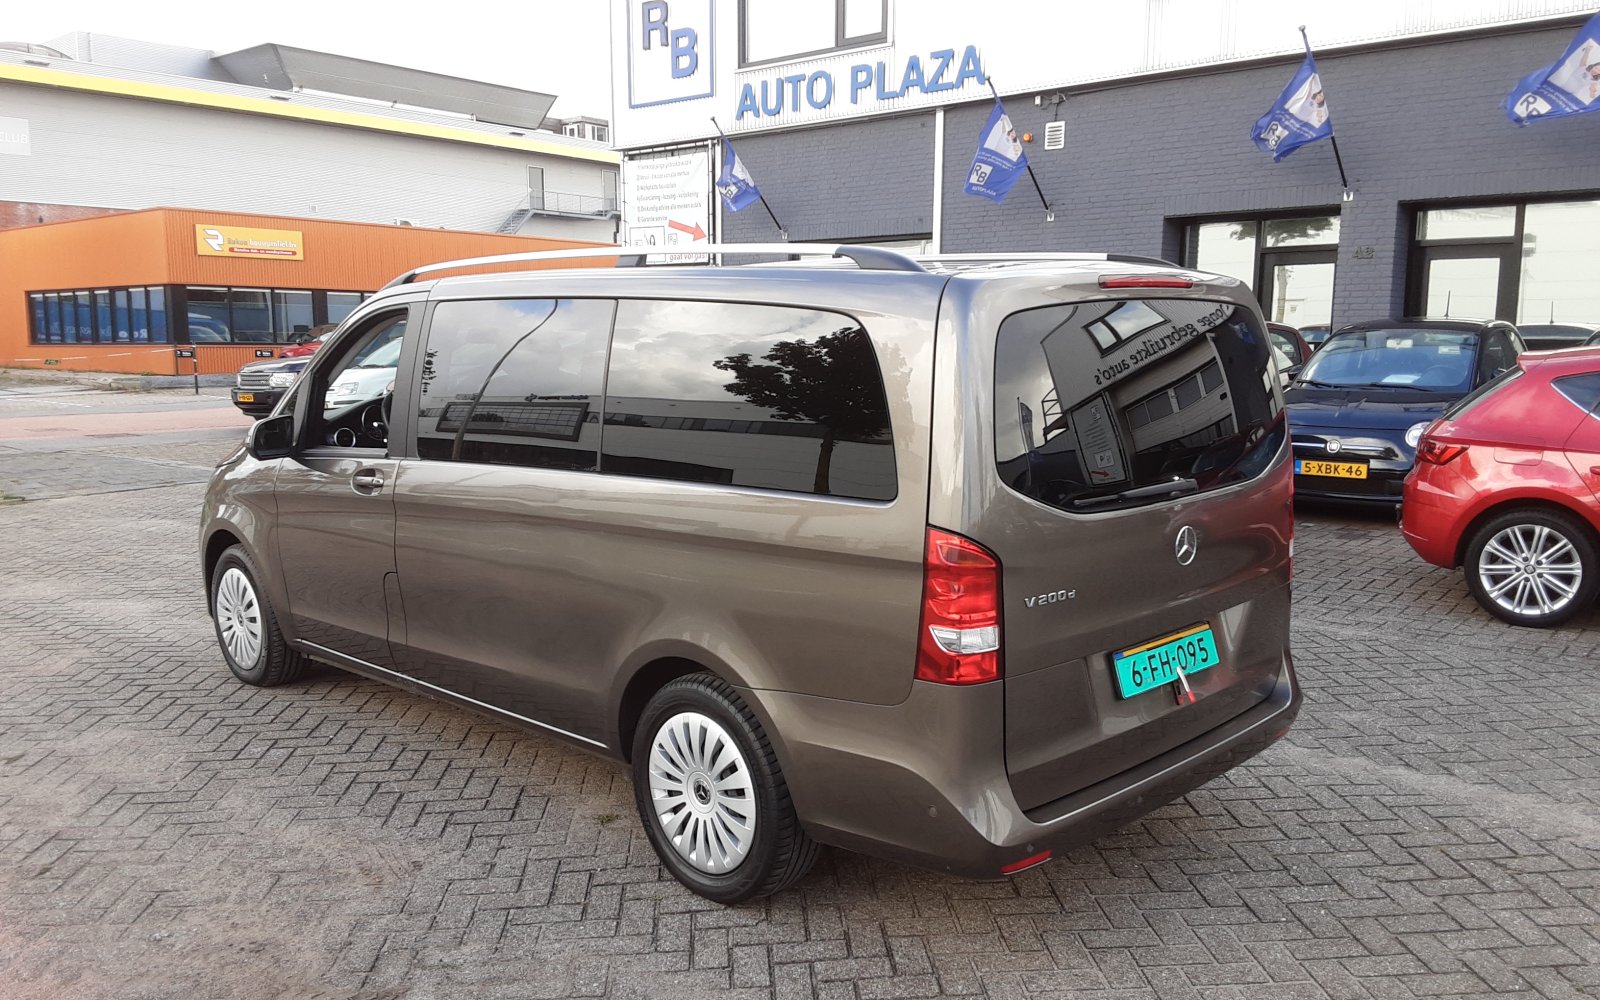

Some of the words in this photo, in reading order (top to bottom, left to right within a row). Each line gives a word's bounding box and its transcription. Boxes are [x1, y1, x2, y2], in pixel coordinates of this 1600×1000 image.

[735, 70, 834, 121] AUTO
[850, 45, 986, 105] PLAZA
[1304, 462, 1363, 477] 5-XBK-46
[1131, 637, 1209, 687] 6-FH-095
